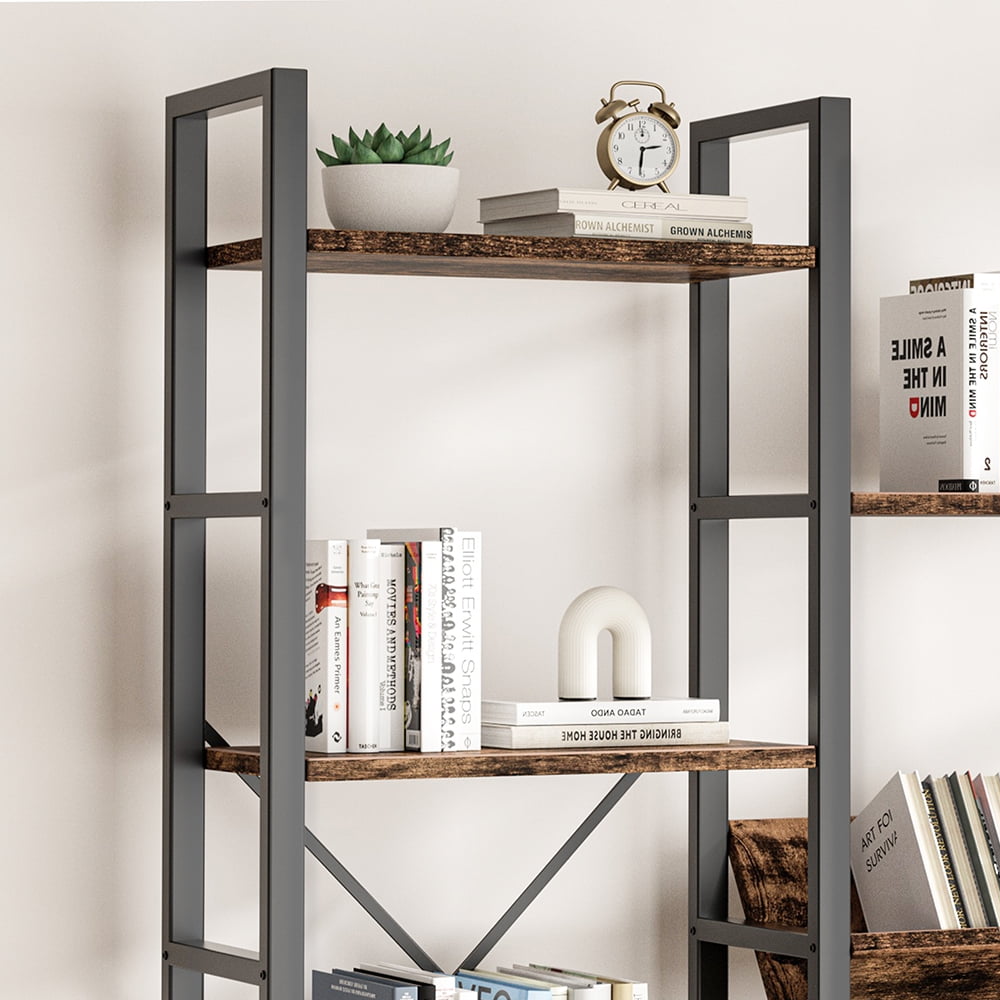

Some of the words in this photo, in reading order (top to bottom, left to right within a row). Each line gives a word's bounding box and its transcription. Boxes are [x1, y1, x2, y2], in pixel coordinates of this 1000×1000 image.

[618, 132, 626, 140] 10
[627, 123, 634, 131] 11
[638, 120, 647, 129] 12
[621, 200, 686, 211] CEREAL
[575, 220, 603, 232] ROWN
[605, 221, 655, 234] ALCHEMIST
[670, 226, 705, 238] GROWN
[707, 227, 752, 240] ALCHEMIS
[462, 537, 476, 590] Elliott
[386, 578, 398, 626] MOVIES
[334, 616, 342, 630] An
[462, 596, 476, 652] Erwitt
[334, 632, 342, 663] Eames
[386, 629, 397, 656] AND
[334, 664, 342, 694] Primer
[386, 657, 397, 712] METHODS
[459, 660, 476, 725] Snaps
[860, 827, 876, 851] ART
